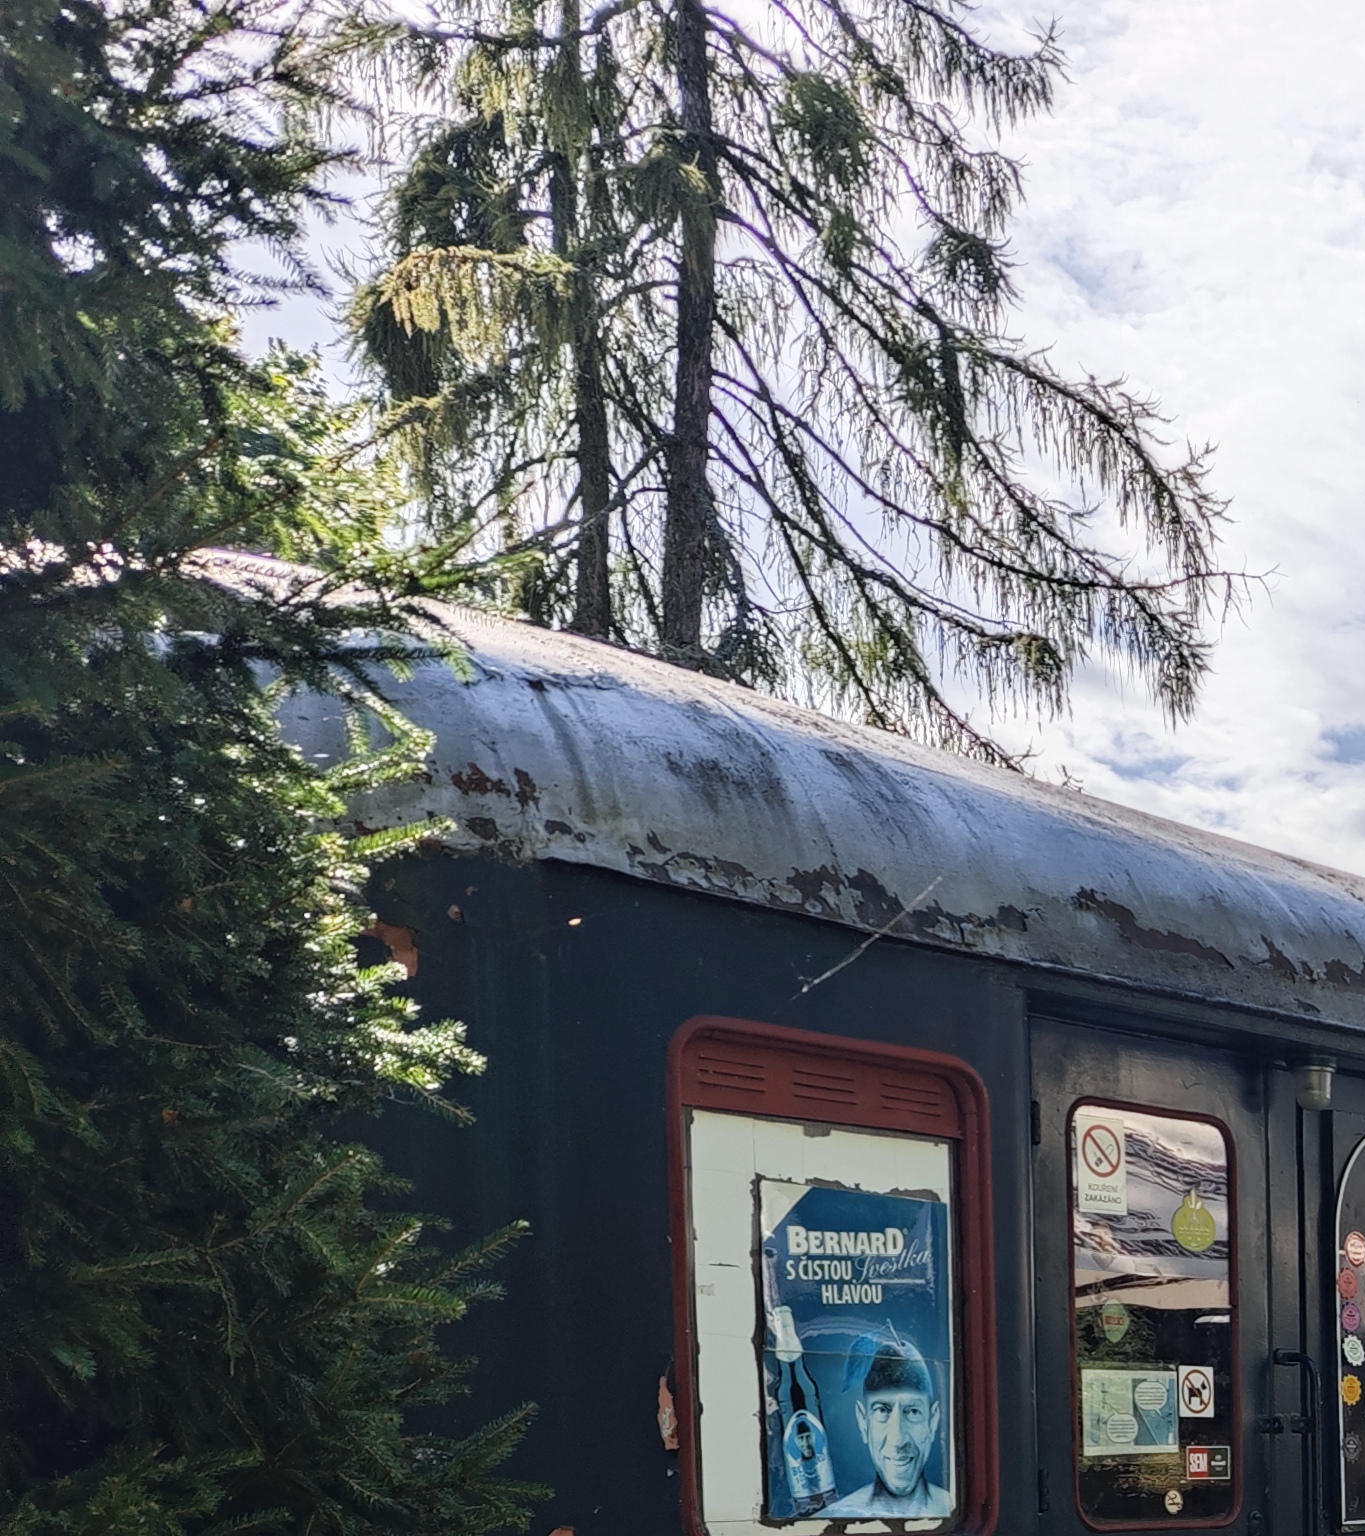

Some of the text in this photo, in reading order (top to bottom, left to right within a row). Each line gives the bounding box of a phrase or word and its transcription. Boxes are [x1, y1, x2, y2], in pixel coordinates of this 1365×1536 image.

[786, 1225, 904, 1256] BERNARD
[786, 1255, 852, 1280] S ČISTOU
[821, 1284, 882, 1304] HLAVOU
